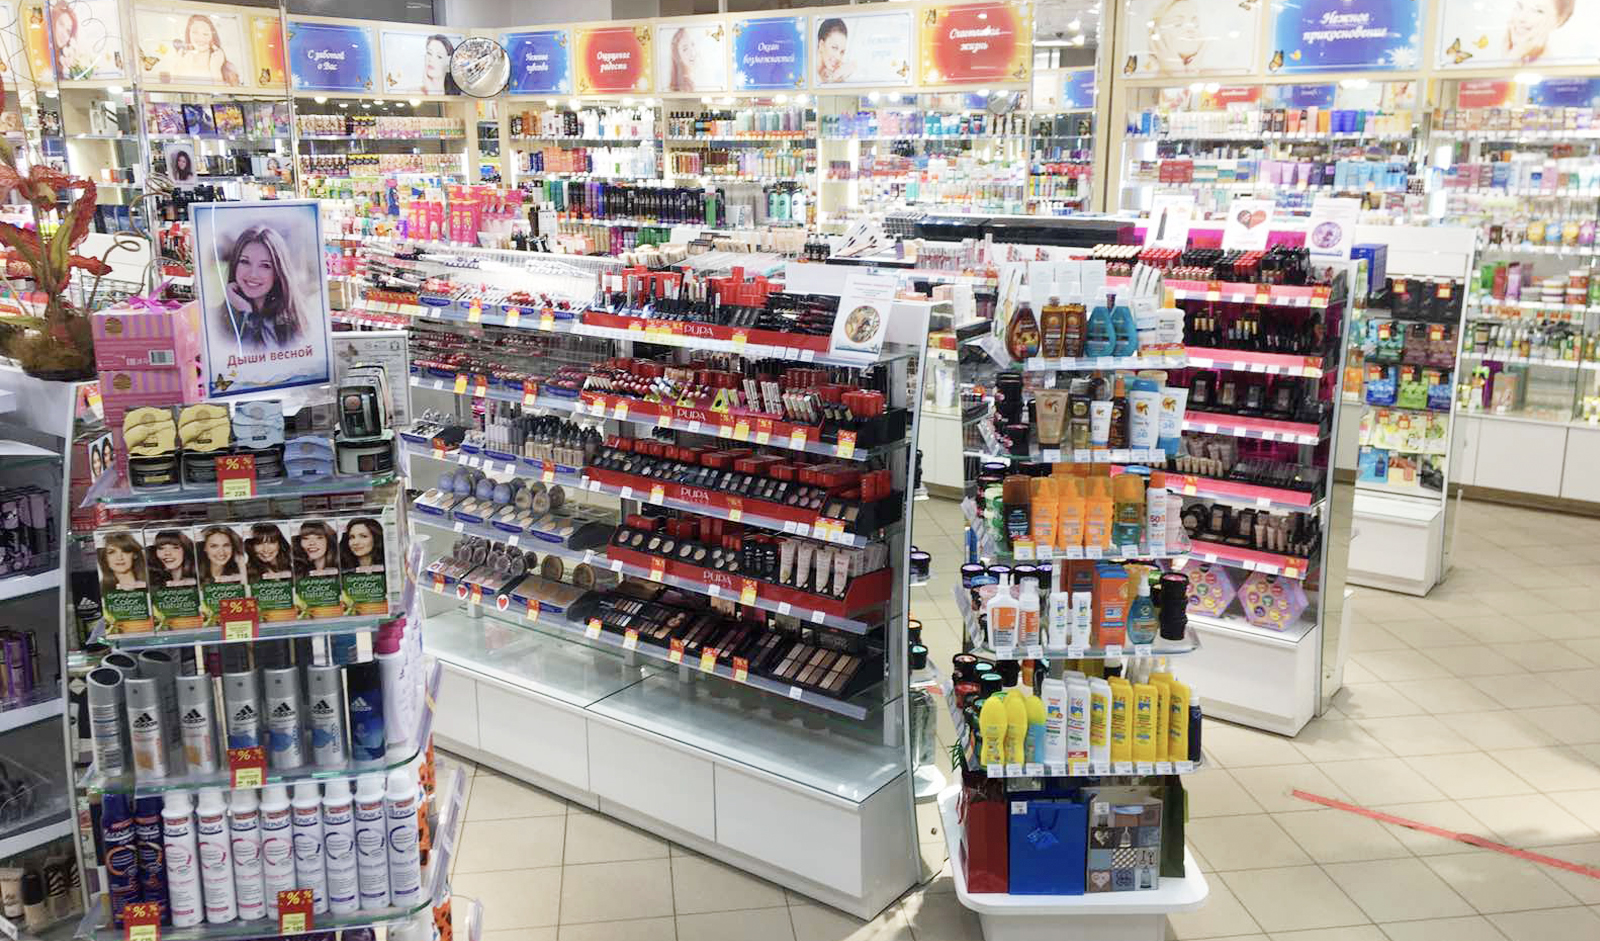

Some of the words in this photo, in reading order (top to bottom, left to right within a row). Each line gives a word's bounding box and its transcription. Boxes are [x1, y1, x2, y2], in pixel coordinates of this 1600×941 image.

[1320, 10, 1370, 24] Нежное
[1302, 25, 1388, 44] прикосновение
[684, 324, 714, 336] PUPA
[227, 353, 266, 369] Дыши
[270, 344, 314, 361] весной
[678, 408, 706, 421] PUPA
[681, 487, 709, 500] PUPA
[704, 570, 732, 585] PUPA
